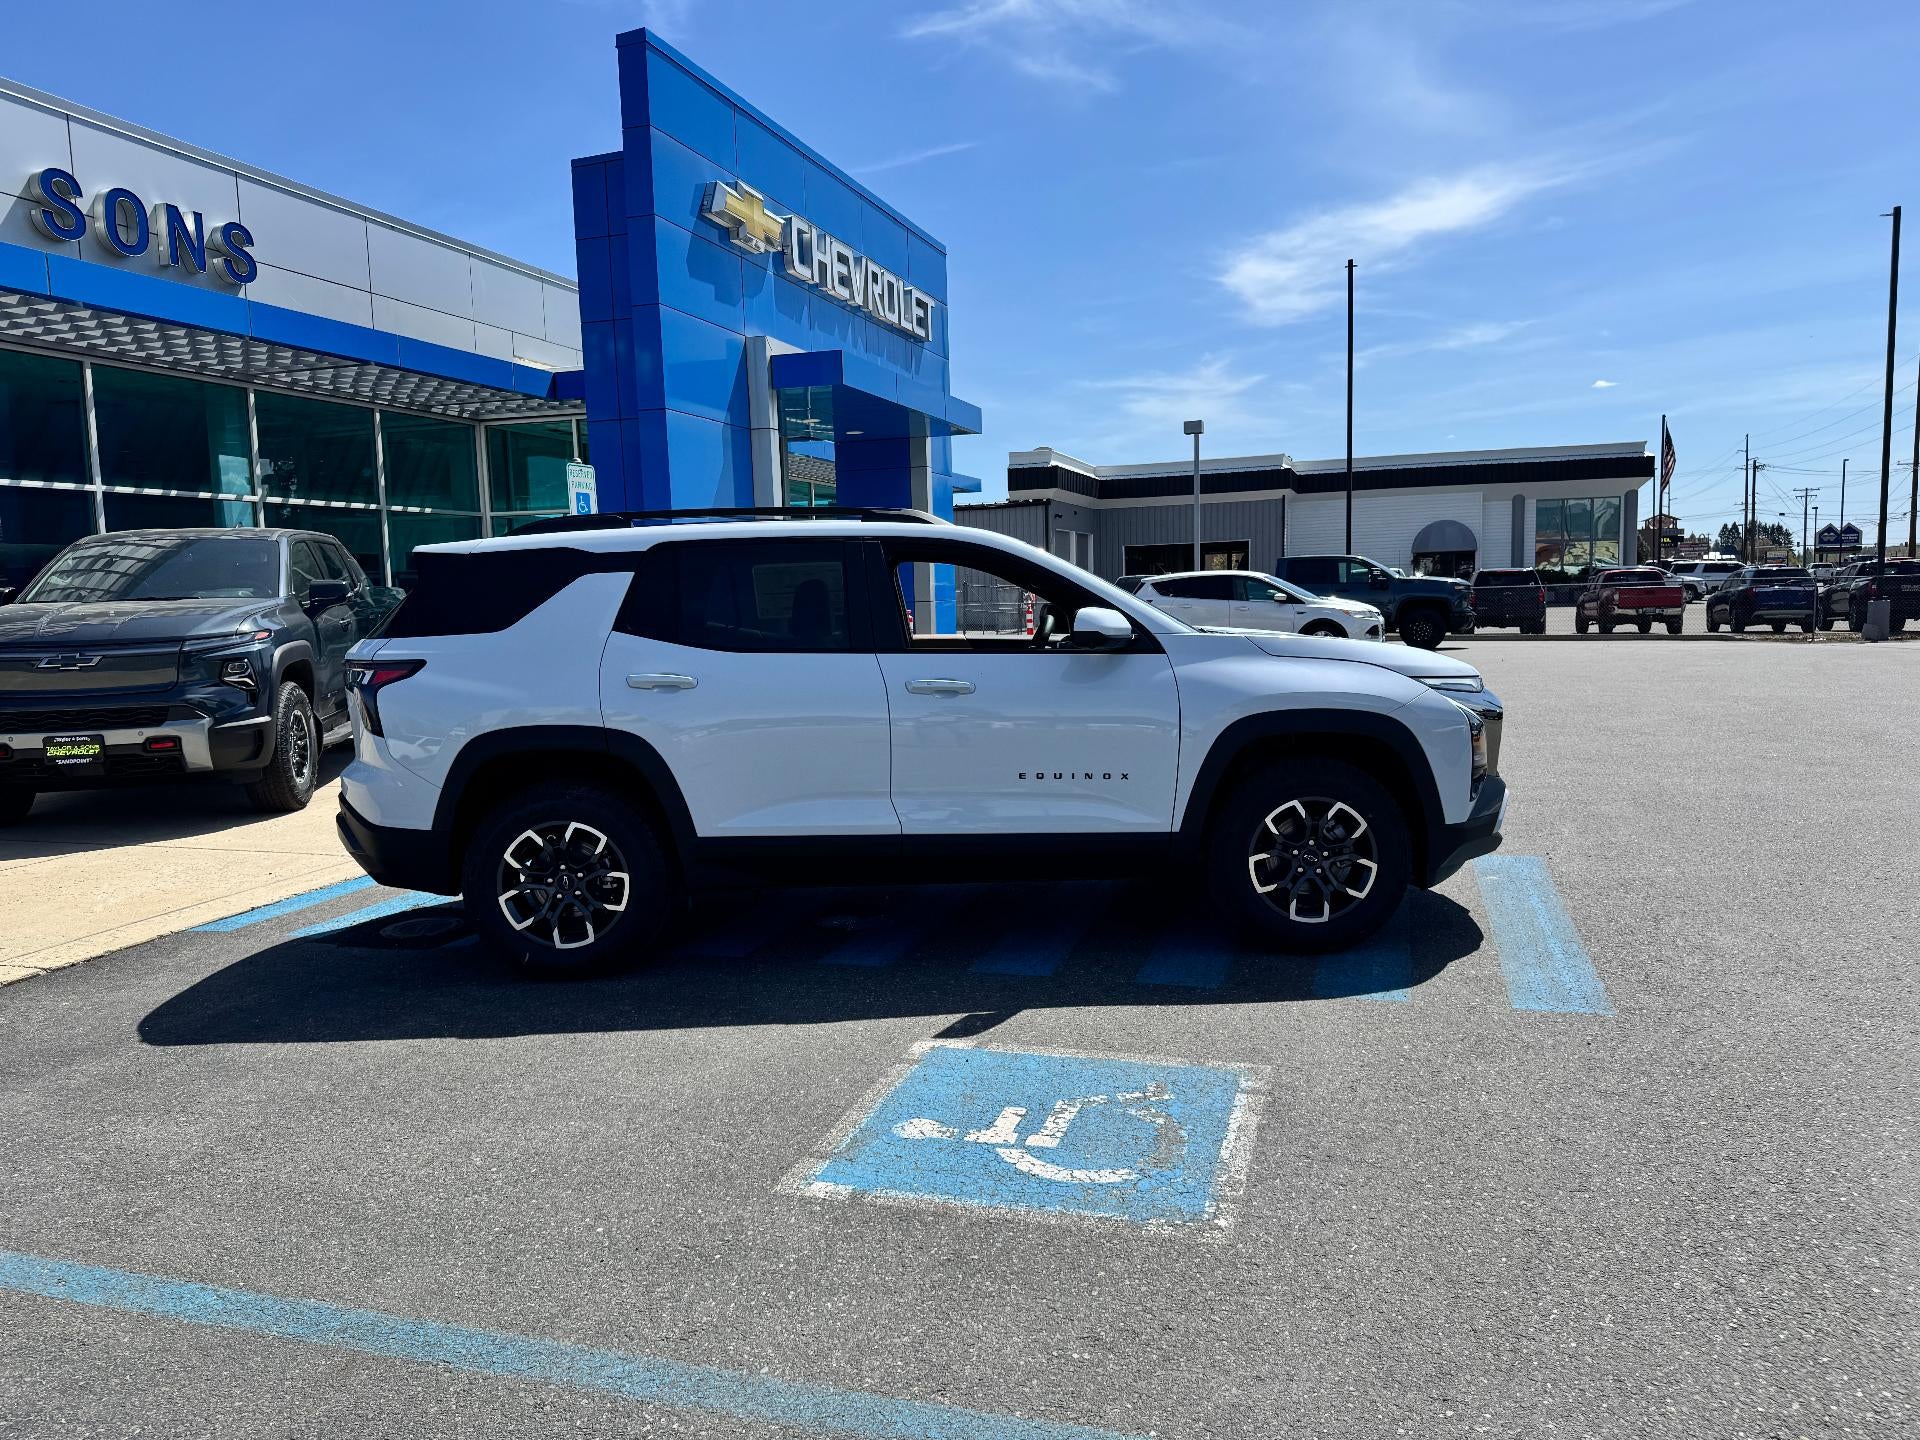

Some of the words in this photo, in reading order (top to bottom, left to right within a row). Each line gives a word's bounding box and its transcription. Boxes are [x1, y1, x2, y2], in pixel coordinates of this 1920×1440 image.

[31, 168, 258, 285] SONS
[784, 215, 936, 342] CHEVROLET
[571, 480, 593, 491] PARKING
[46, 749, 100, 757] CHEVROLET
[1018, 772, 1129, 780] EQUINOX
